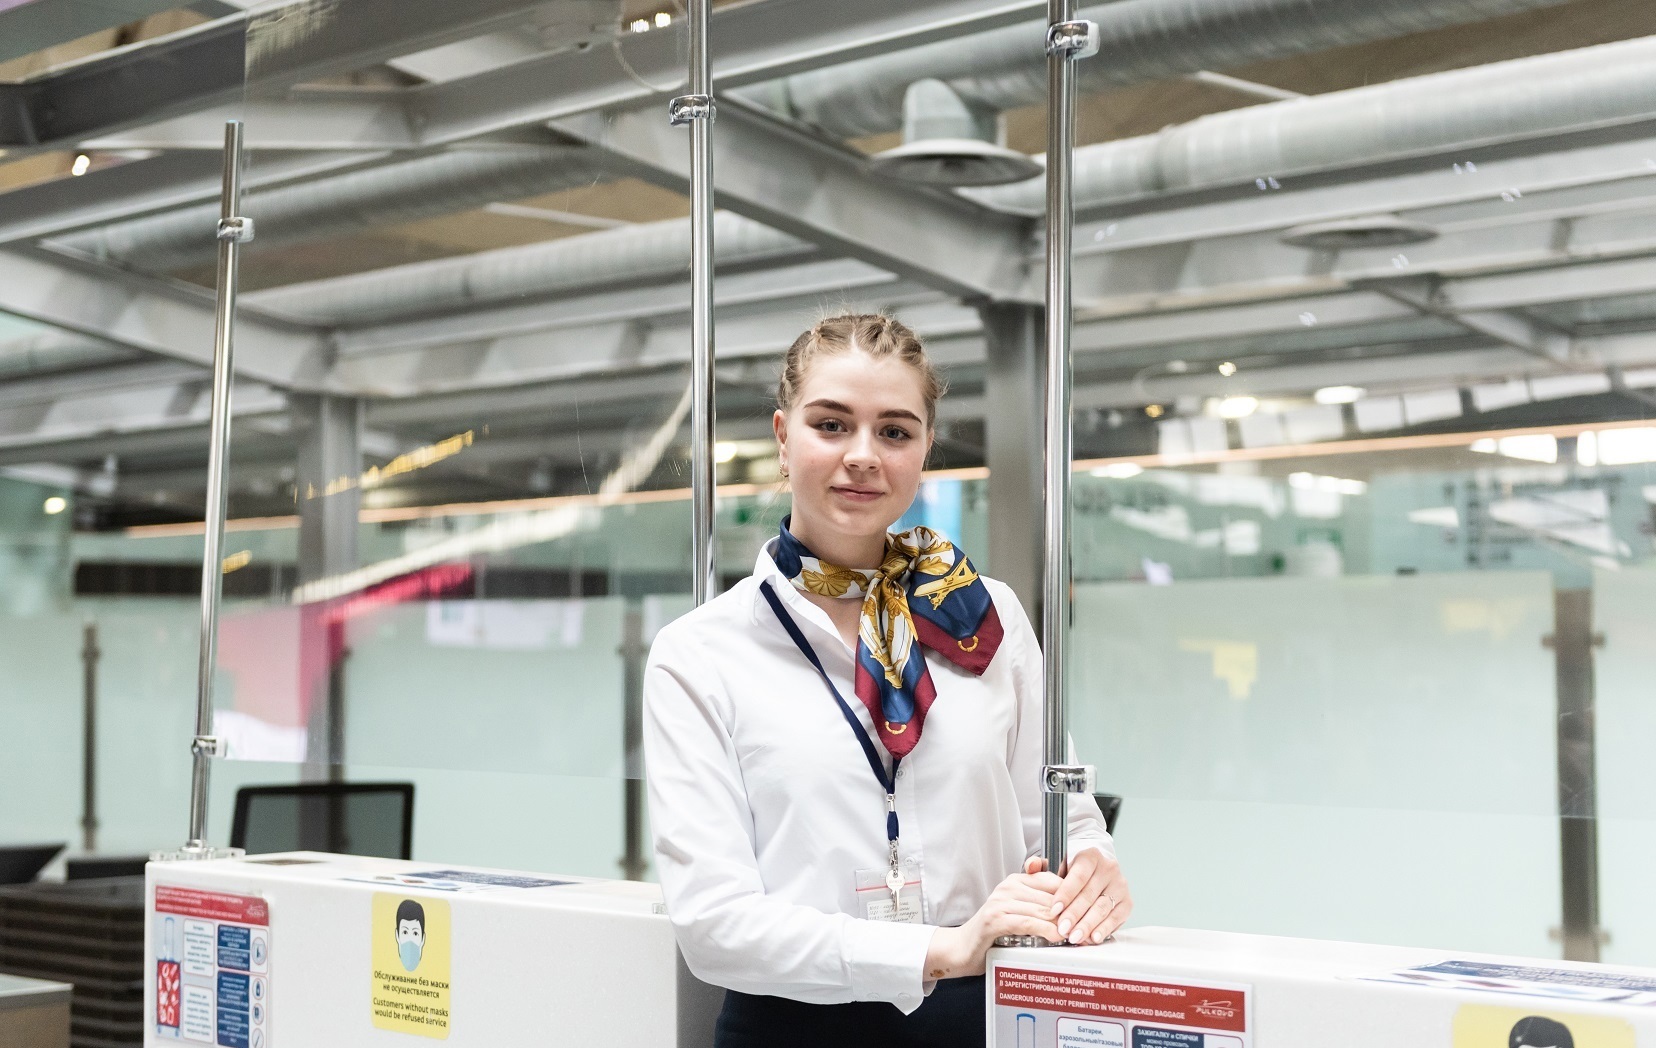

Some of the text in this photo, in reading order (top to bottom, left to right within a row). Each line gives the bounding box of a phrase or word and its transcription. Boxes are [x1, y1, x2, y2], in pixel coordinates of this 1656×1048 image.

[374, 970, 449, 990] Обслуживание без маски
[999, 971, 1027, 981] ОПАСНЫЕ
[1028, 974, 1059, 984] ВЕЩЕСТВА
[1065, 977, 1110, 989] ЗАПРЕЩЕННЫЕ
[1111, 982, 1115, 990] К
[1116, 982, 1150, 993] ПЕРЕВОЗКЕ
[1151, 986, 1186, 997] ПРЕДМЕТЫ
[1005, 981, 1071, 994] ЗАРЕГИСТРИРОВАННОМ
[1071, 987, 1095, 996] БАГАЖЕ
[383, 983, 440, 999] не осуществляется
[373, 997, 449, 1017] Customers without masks
[999, 993, 1185, 1019] DANGEROUS GOODS NOT PERMITTED IN YOUR CHECKED BAGGAGE
[374, 1008, 447, 1028] would be refused service
[1137, 1028, 1170, 1038] ЗАЖИГАЛКУ
[1175, 1033, 1199, 1042] СПИЧКИ
